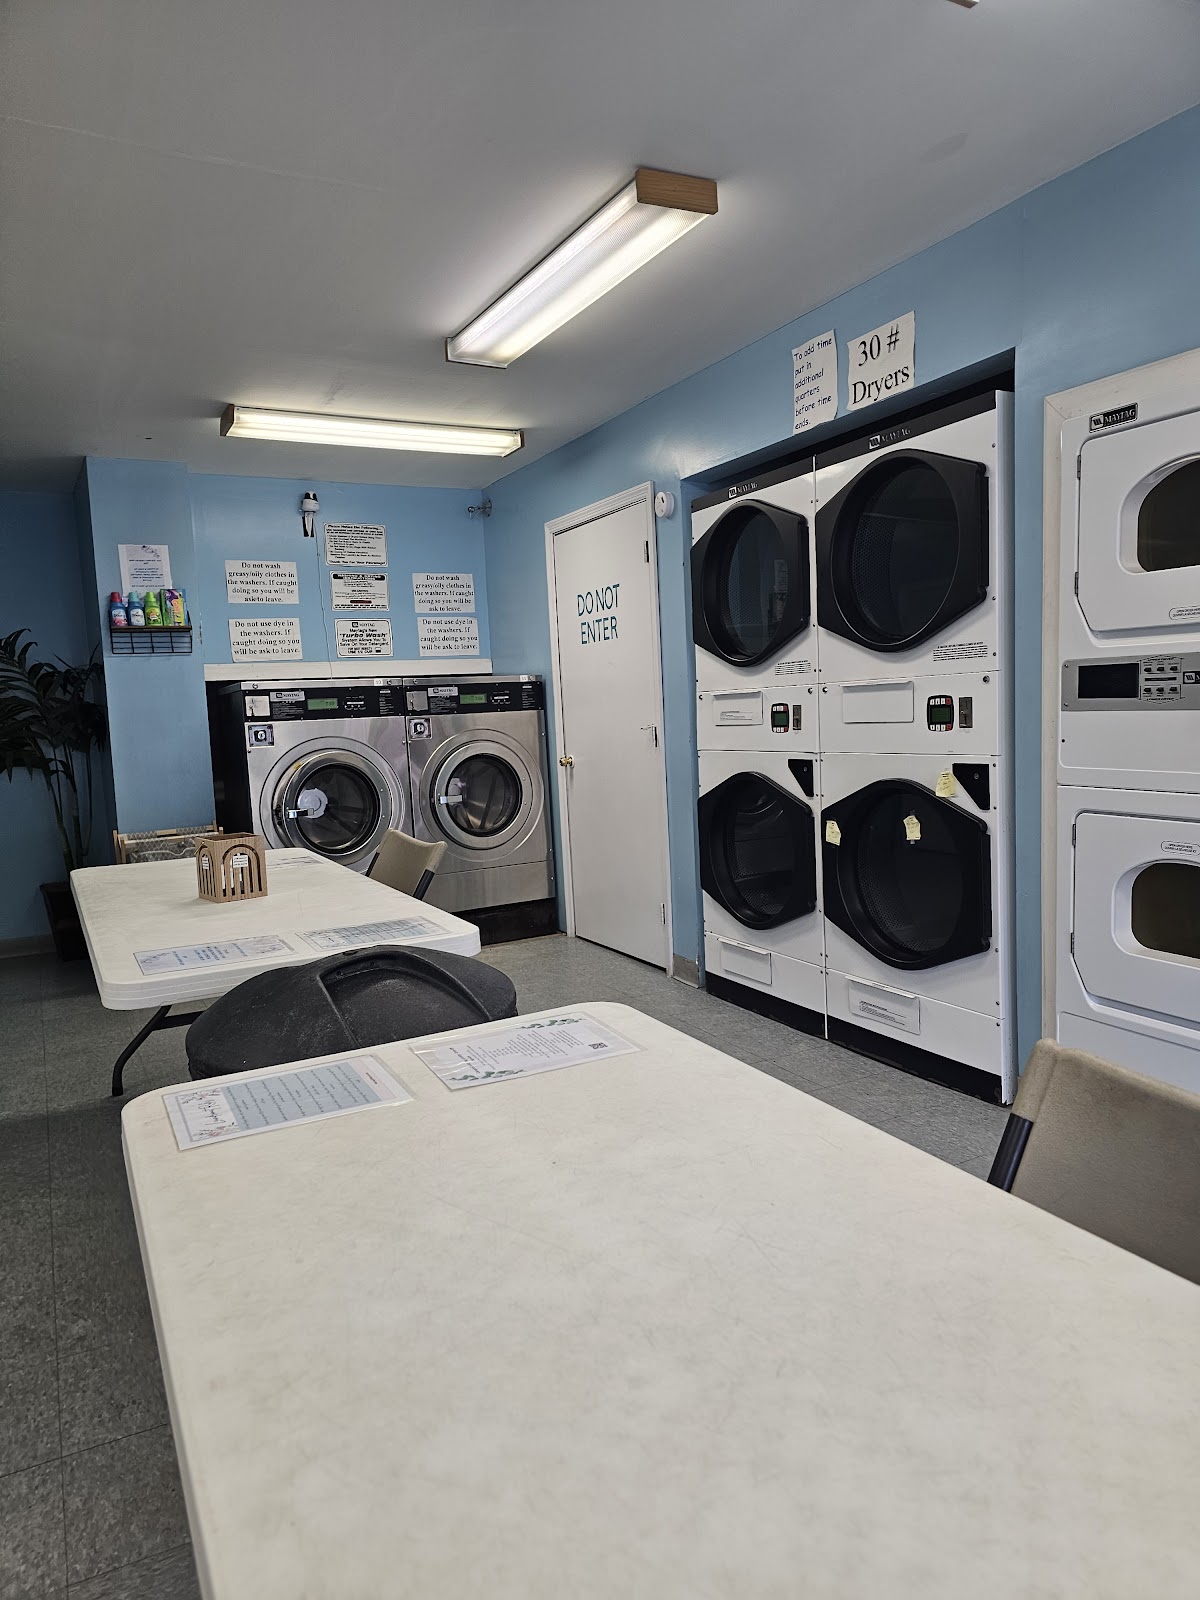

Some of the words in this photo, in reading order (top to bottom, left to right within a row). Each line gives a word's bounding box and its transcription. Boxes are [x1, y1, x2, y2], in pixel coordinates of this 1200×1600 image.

[794, 353, 802, 361] To
[804, 343, 814, 357] add
[817, 338, 832, 349] time
[858, 334, 880, 367] 30
[887, 323, 900, 353] #
[795, 366, 804, 378] put
[807, 361, 811, 370] in
[795, 368, 824, 389] additional
[795, 386, 819, 404] quarters
[852, 366, 910, 404] Dryers
[796, 402, 815, 416] before
[818, 395, 831, 407] time
[1105, 409, 1135, 422] MAYTAG
[795, 418, 810, 430] ends.
[577, 592, 593, 616] DO
[596, 584, 619, 612] NOT
[273, 620, 285, 628] dye
[581, 616, 618, 644] ENTER
